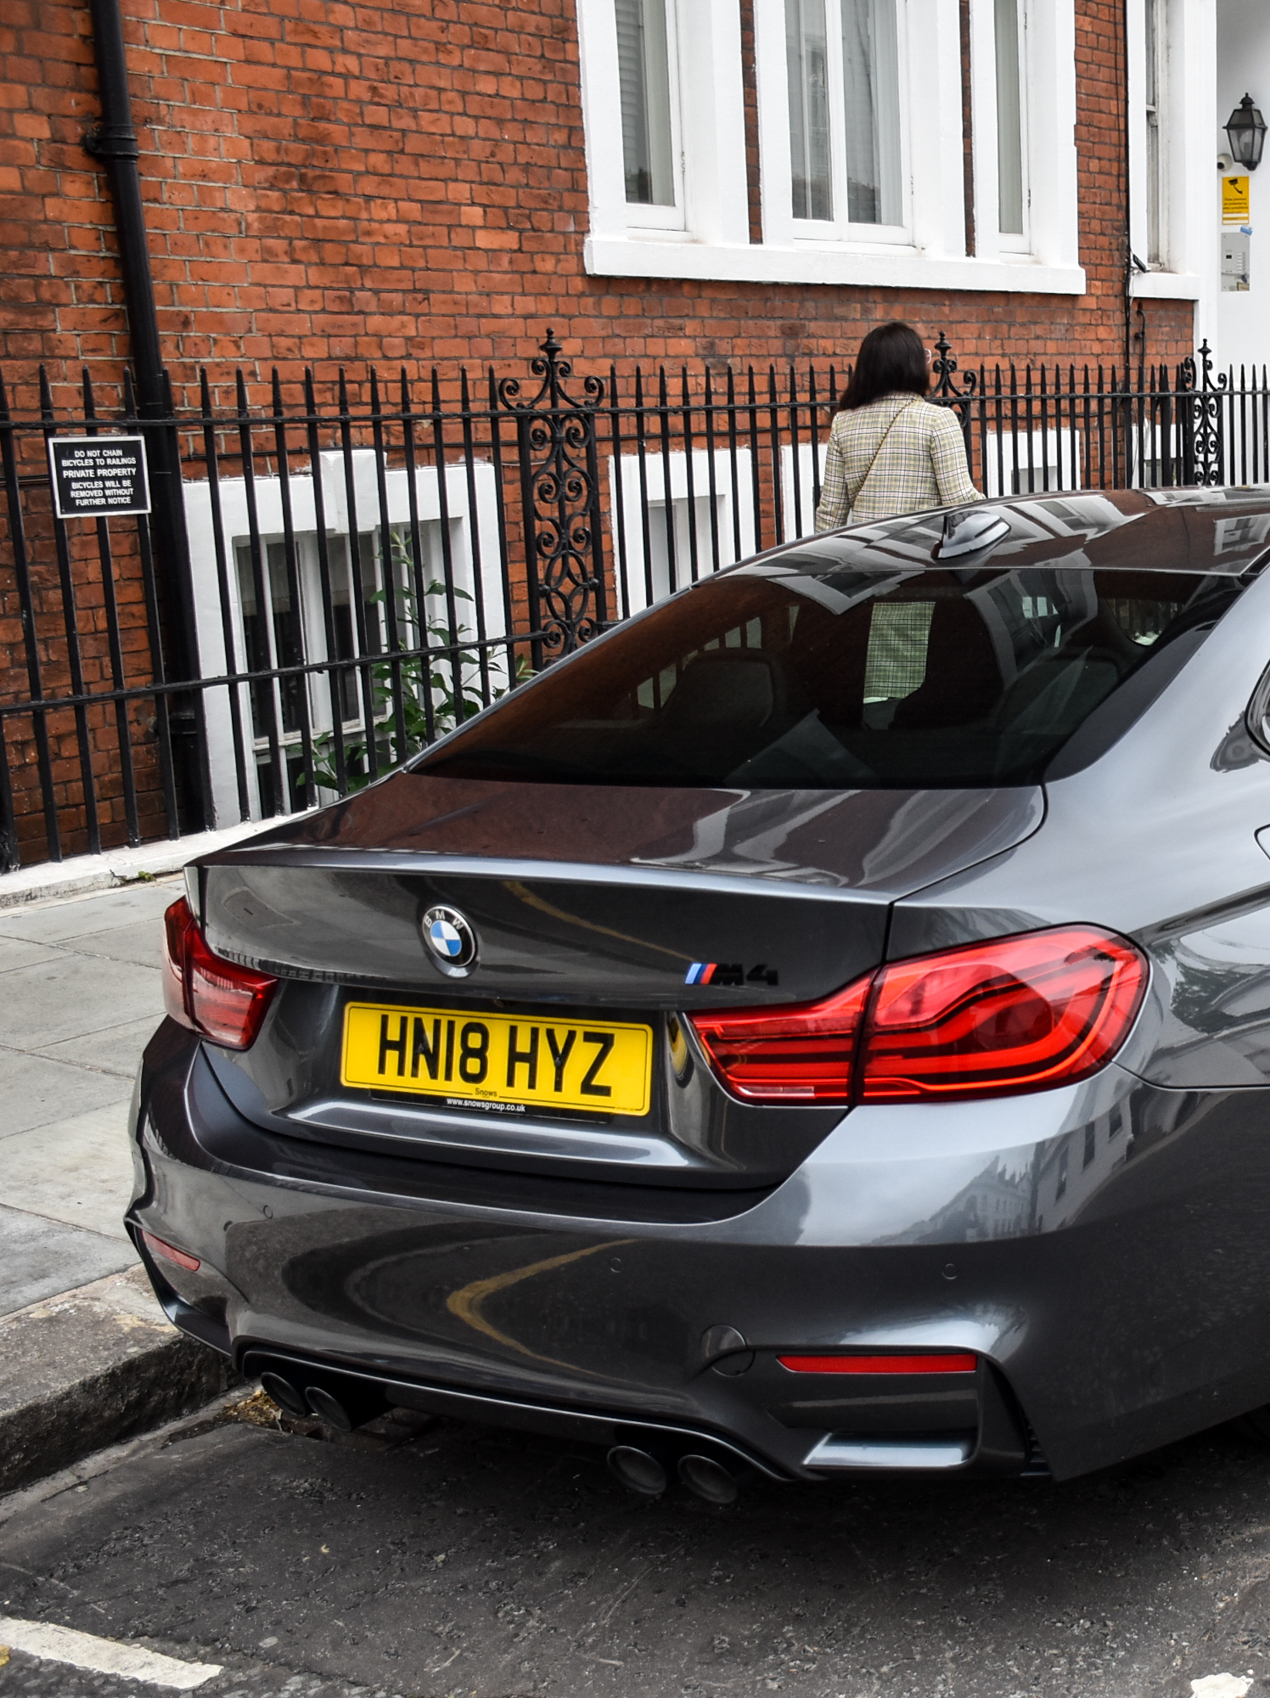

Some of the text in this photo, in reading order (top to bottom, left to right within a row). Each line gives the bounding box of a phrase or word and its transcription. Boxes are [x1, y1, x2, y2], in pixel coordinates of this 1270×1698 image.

[74, 450, 85, 458] DO
[102, 449, 123, 457] CHAIN
[61, 457, 137, 467] BICYCLES TO RAILINGS
[62, 468, 137, 478] PRIVATE PROPERTY
[71, 481, 103, 489] BICYCLES
[104, 480, 121, 488] WILL
[70, 488, 134, 498] REMOVED WITHOUT
[75, 497, 131, 506] FURTHER NOTICE
[424, 910, 465, 930] BMW
[710, 963, 779, 986] M4
[377, 1014, 615, 1097] HN18 HYZ
[475, 1088, 497, 1097] Snows
[446, 1098, 526, 1112] www.snowsgroup.co.uk
